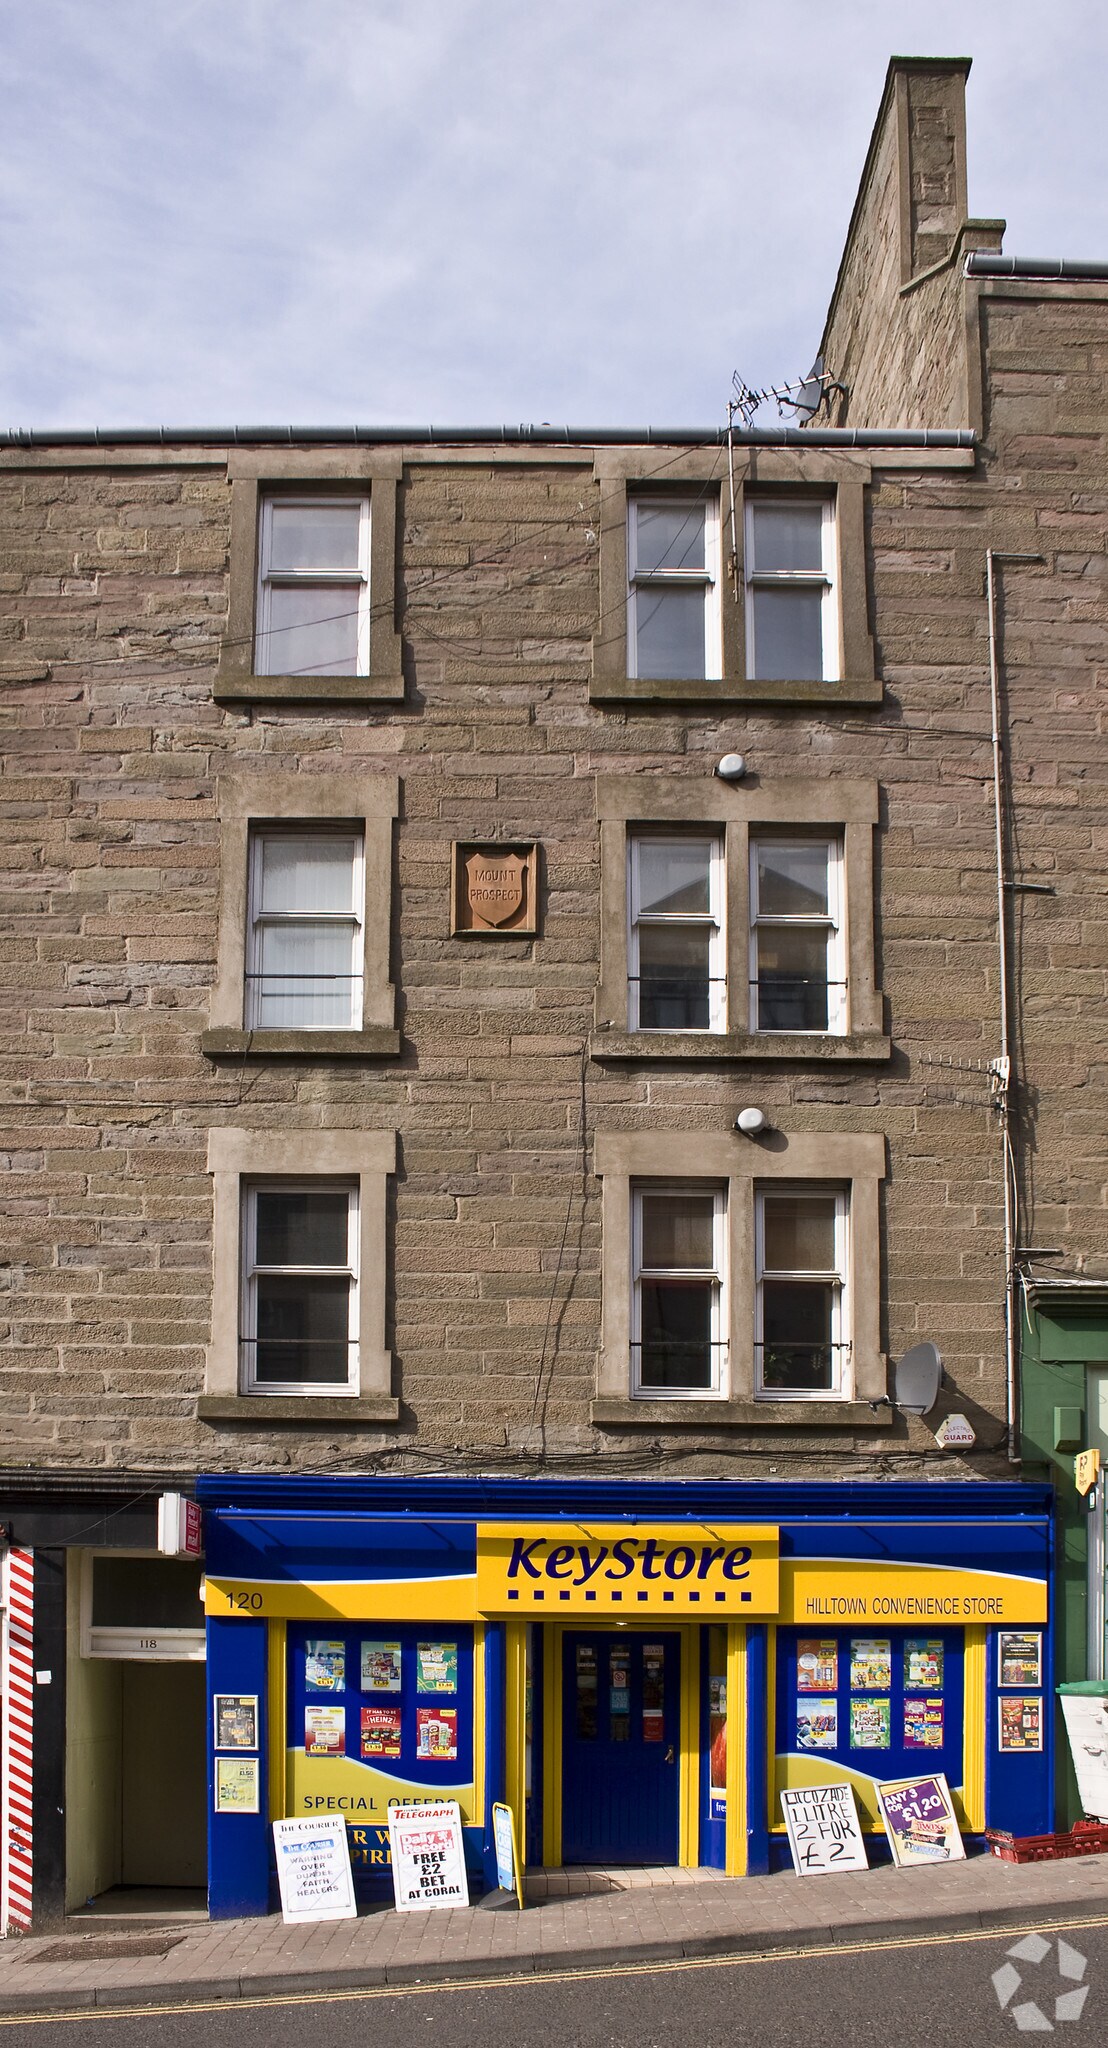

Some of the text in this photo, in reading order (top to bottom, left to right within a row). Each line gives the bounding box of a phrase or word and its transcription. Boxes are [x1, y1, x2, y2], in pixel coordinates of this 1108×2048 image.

[475, 870, 516, 881] MOUNT
[470, 889, 521, 901] PROSPECT
[507, 1537, 753, 1586] KeyStore
[225, 1592, 263, 1610] 120
[806, 1597, 1004, 1615] HILLTOWN CONVENIENCE STORE
[140, 1639, 157, 1649] 118
[370, 1716, 394, 1724] HEINZ
[303, 1796, 378, 1810] SPECIAL
[884, 1788, 918, 1807] ANY 3
[715, 1802, 727, 1812] fre
[792, 1808, 801, 1823] 1
[803, 1802, 852, 1822] LITRE
[886, 1803, 904, 1814] FOR
[902, 1794, 942, 1822] £1.20
[394, 1808, 454, 1820] TELEGRAPH
[796, 1819, 857, 1840] 2 FOR
[917, 1821, 941, 1832] TWIX
[375, 1829, 391, 1845] W
[401, 1832, 436, 1845] Daily
[402, 1841, 451, 1855] Record
[290, 1853, 333, 1864] WARNING
[413, 1851, 447, 1865] FREE
[300, 1862, 326, 1871] OVER
[421, 1863, 442, 1876] £2
[296, 1870, 334, 1880] DUNDEE
[420, 1874, 446, 1888] BET
[302, 1878, 330, 1888] FAITH
[297, 1885, 339, 1897] HEALERS
[408, 1885, 461, 1900] AT CORAL
